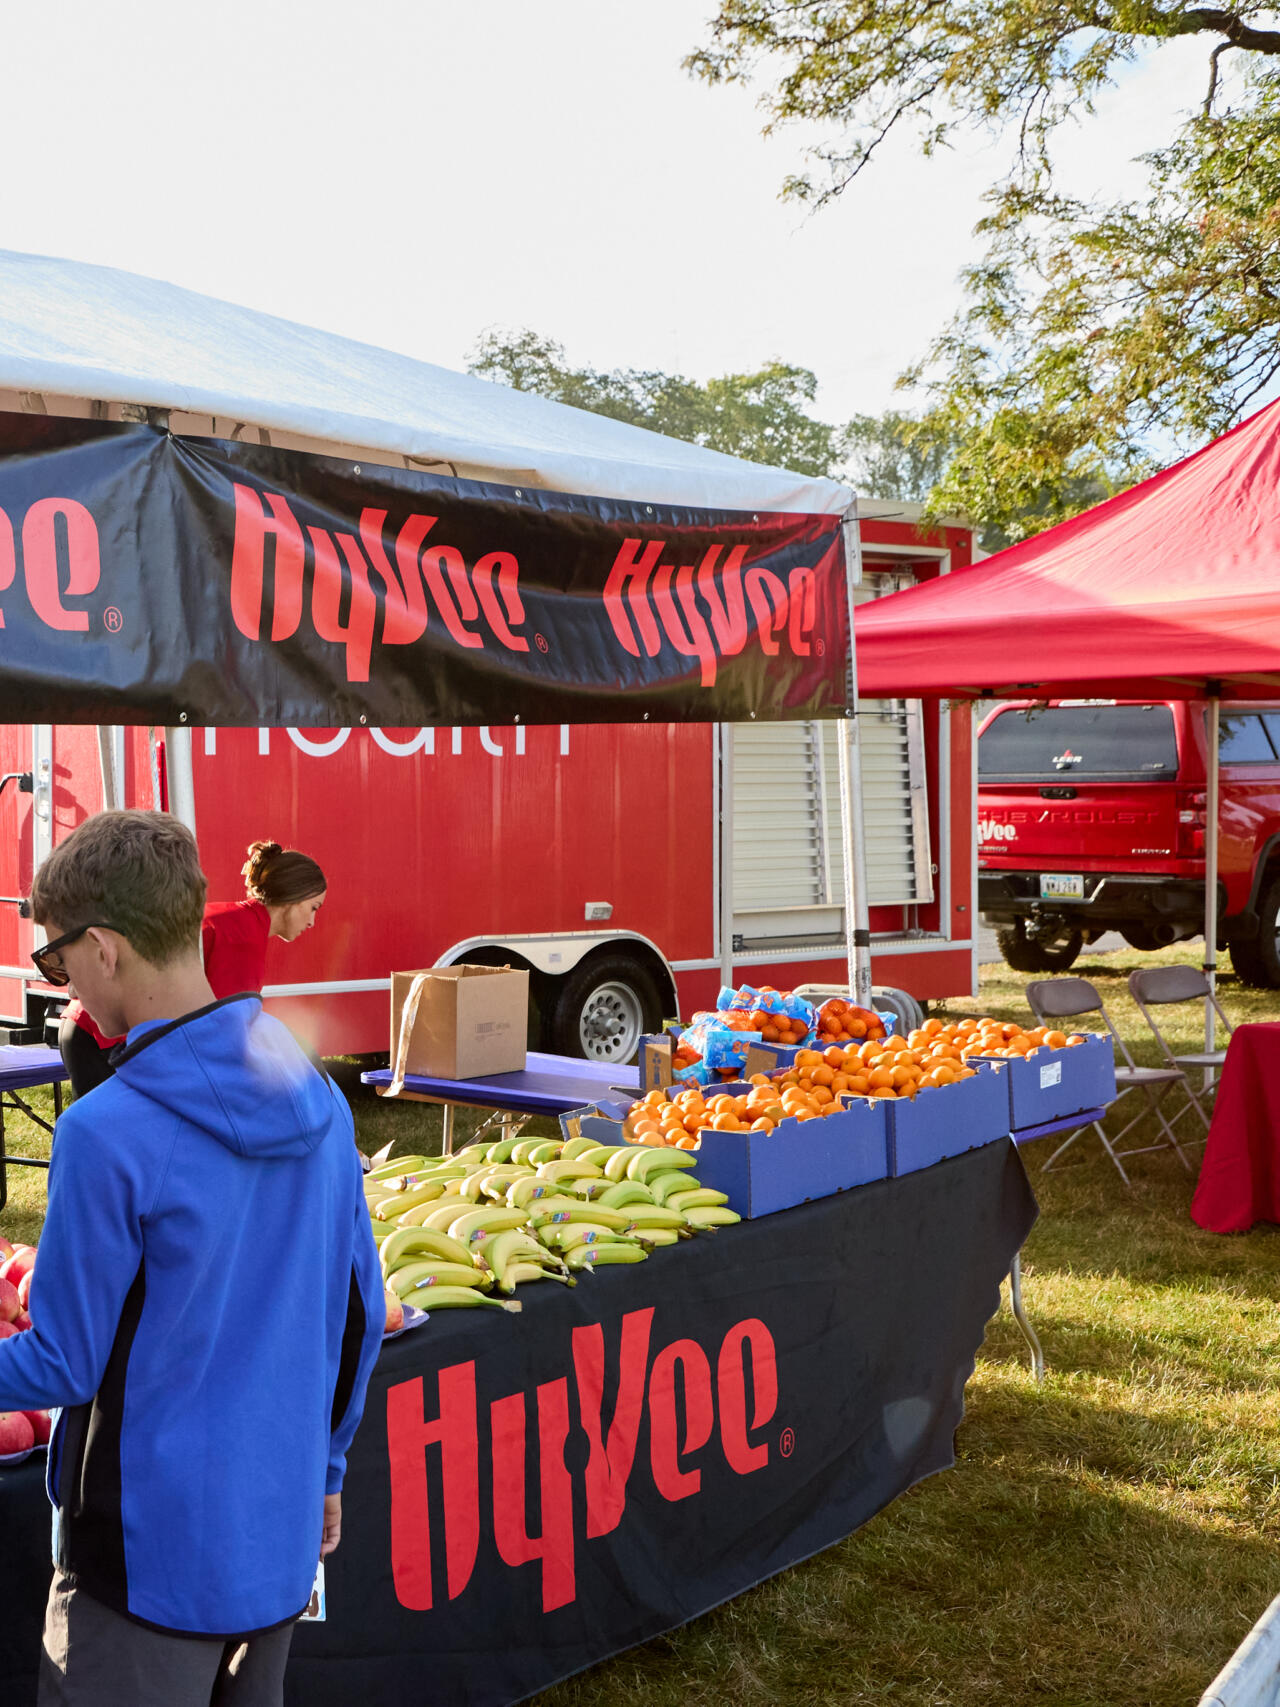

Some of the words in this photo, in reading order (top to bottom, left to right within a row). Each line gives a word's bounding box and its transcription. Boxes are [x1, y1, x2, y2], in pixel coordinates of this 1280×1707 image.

[230, 482, 529, 682] HyVee
[602, 538, 816, 687] HyVee
[386, 1306, 778, 1614] HyVee
